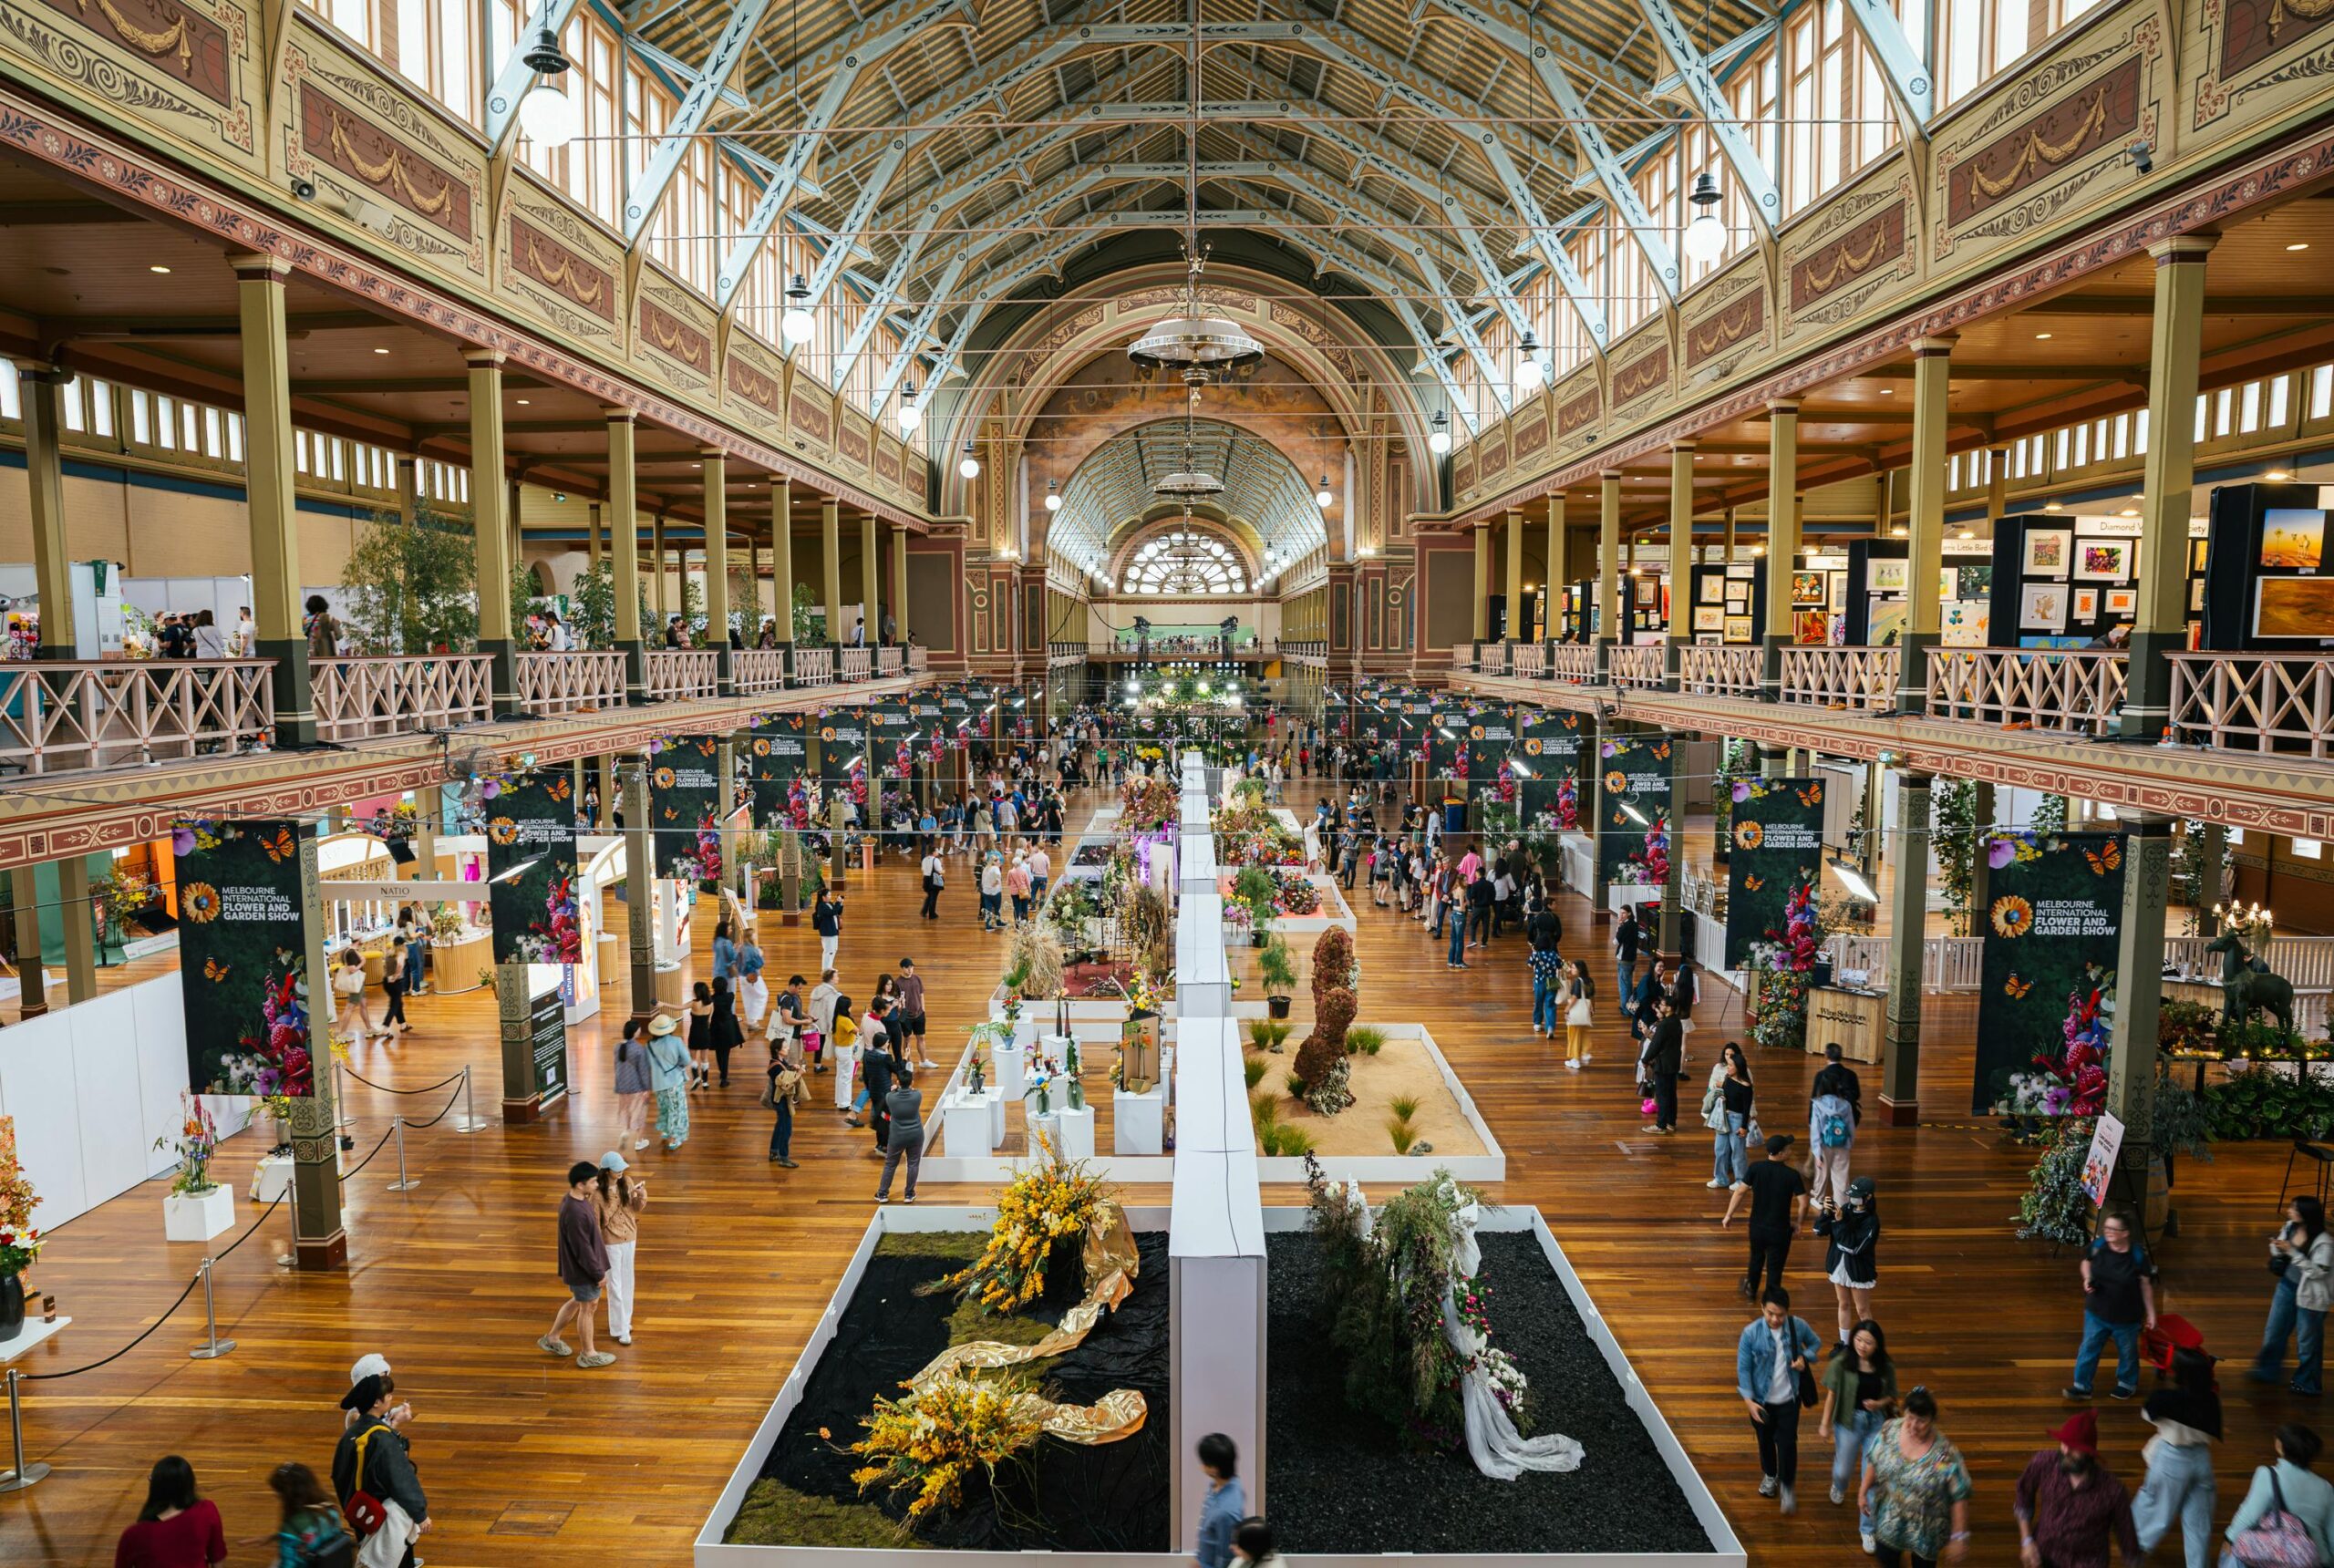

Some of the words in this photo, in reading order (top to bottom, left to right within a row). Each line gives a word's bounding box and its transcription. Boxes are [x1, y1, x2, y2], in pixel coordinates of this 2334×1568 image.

[2100, 522, 2135, 531] Diamond
[2188, 524, 2206, 535] ciety
[222, 887, 275, 895] MELBOURNE
[380, 887, 409, 895] NATIO
[223, 903, 265, 912] FLOWER
[267, 903, 290, 912] AND
[223, 913, 265, 921] GARDEN
[267, 913, 299, 922] SHOW
[2036, 909, 2109, 917] INTERNATIONAL
[2035, 917, 2081, 926] FLOWER
[2082, 918, 2107, 926] AND
[2034, 926, 2080, 935] GARDEN
[2081, 926, 2116, 935] SHOW
[1820, 1007, 1836, 1016] Wine
[1837, 1010, 1866, 1021] Selectors
